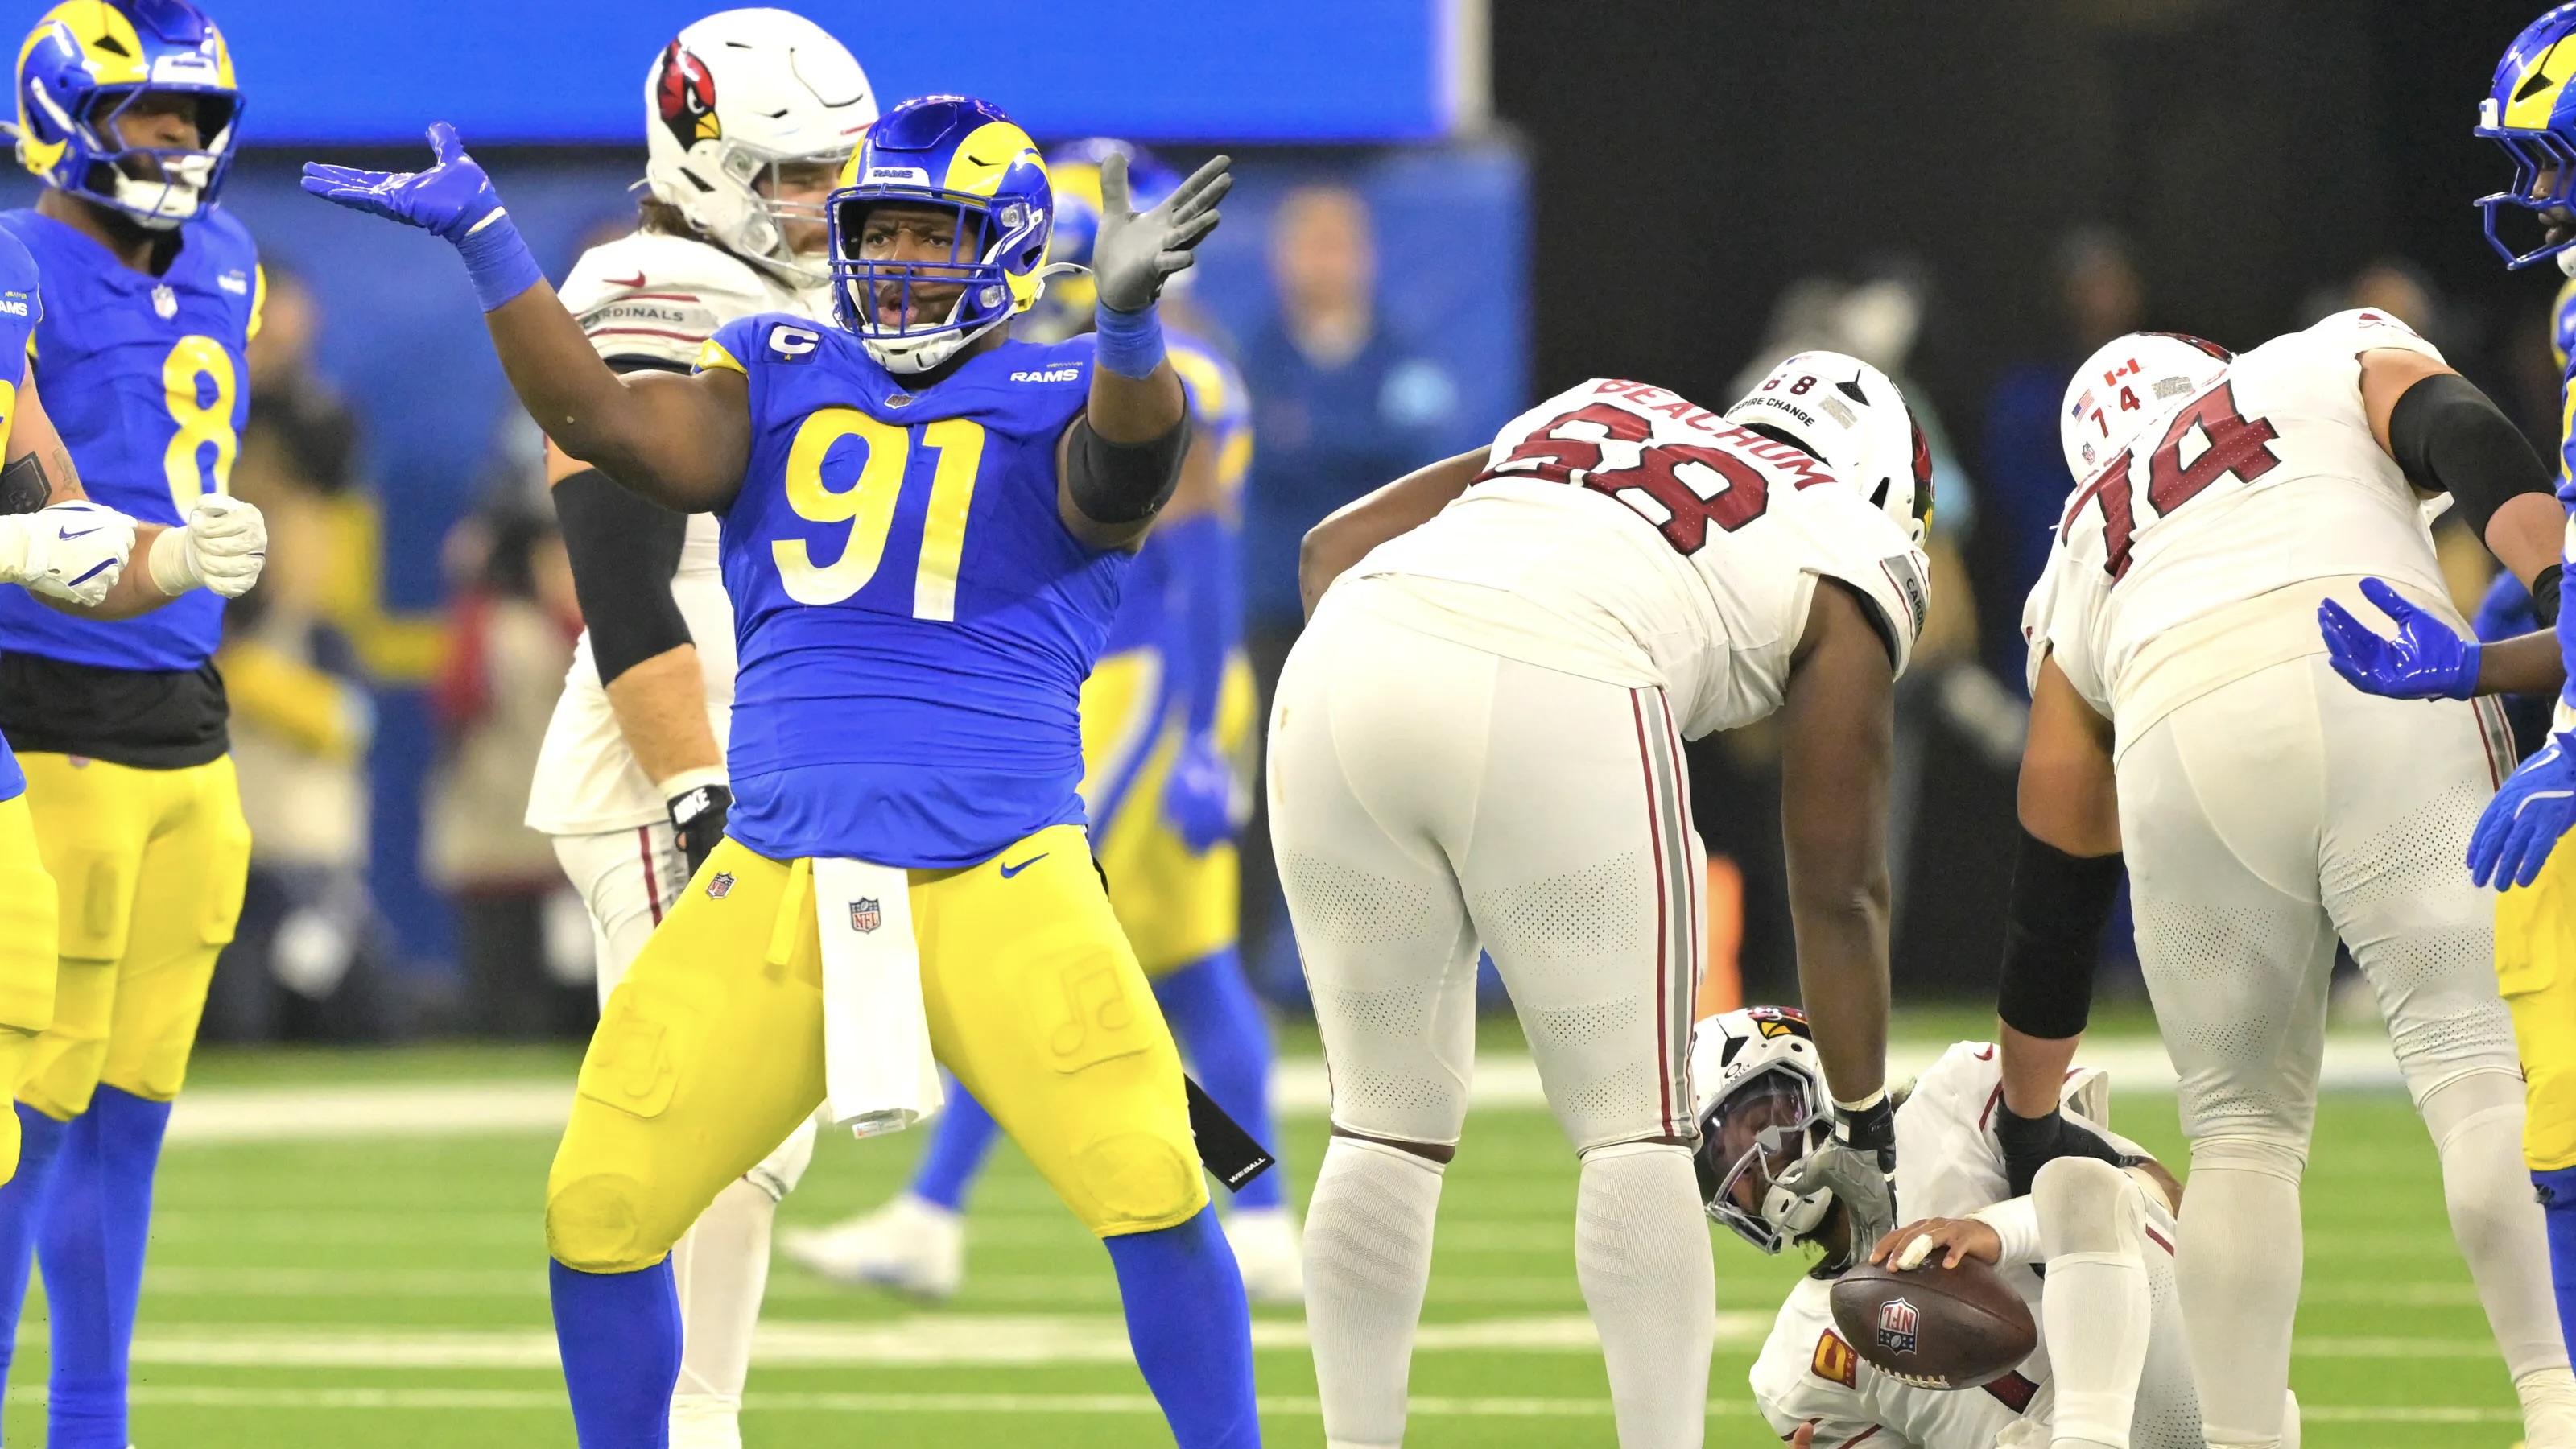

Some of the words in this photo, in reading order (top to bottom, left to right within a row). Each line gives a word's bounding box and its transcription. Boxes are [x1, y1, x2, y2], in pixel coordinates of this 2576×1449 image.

[873, 169, 914, 179] RAMS
[769, 325, 819, 354] C
[1010, 369, 1079, 382] RAMS
[1766, 398, 1815, 427] CHANGE
[163, 335, 237, 523] 8
[1593, 379, 1839, 492] BEACHUM
[2062, 378, 2282, 593] 74
[772, 408, 985, 623] 91
[854, 912, 878, 929] NFL
[1884, 1305, 1914, 1334] NFL
